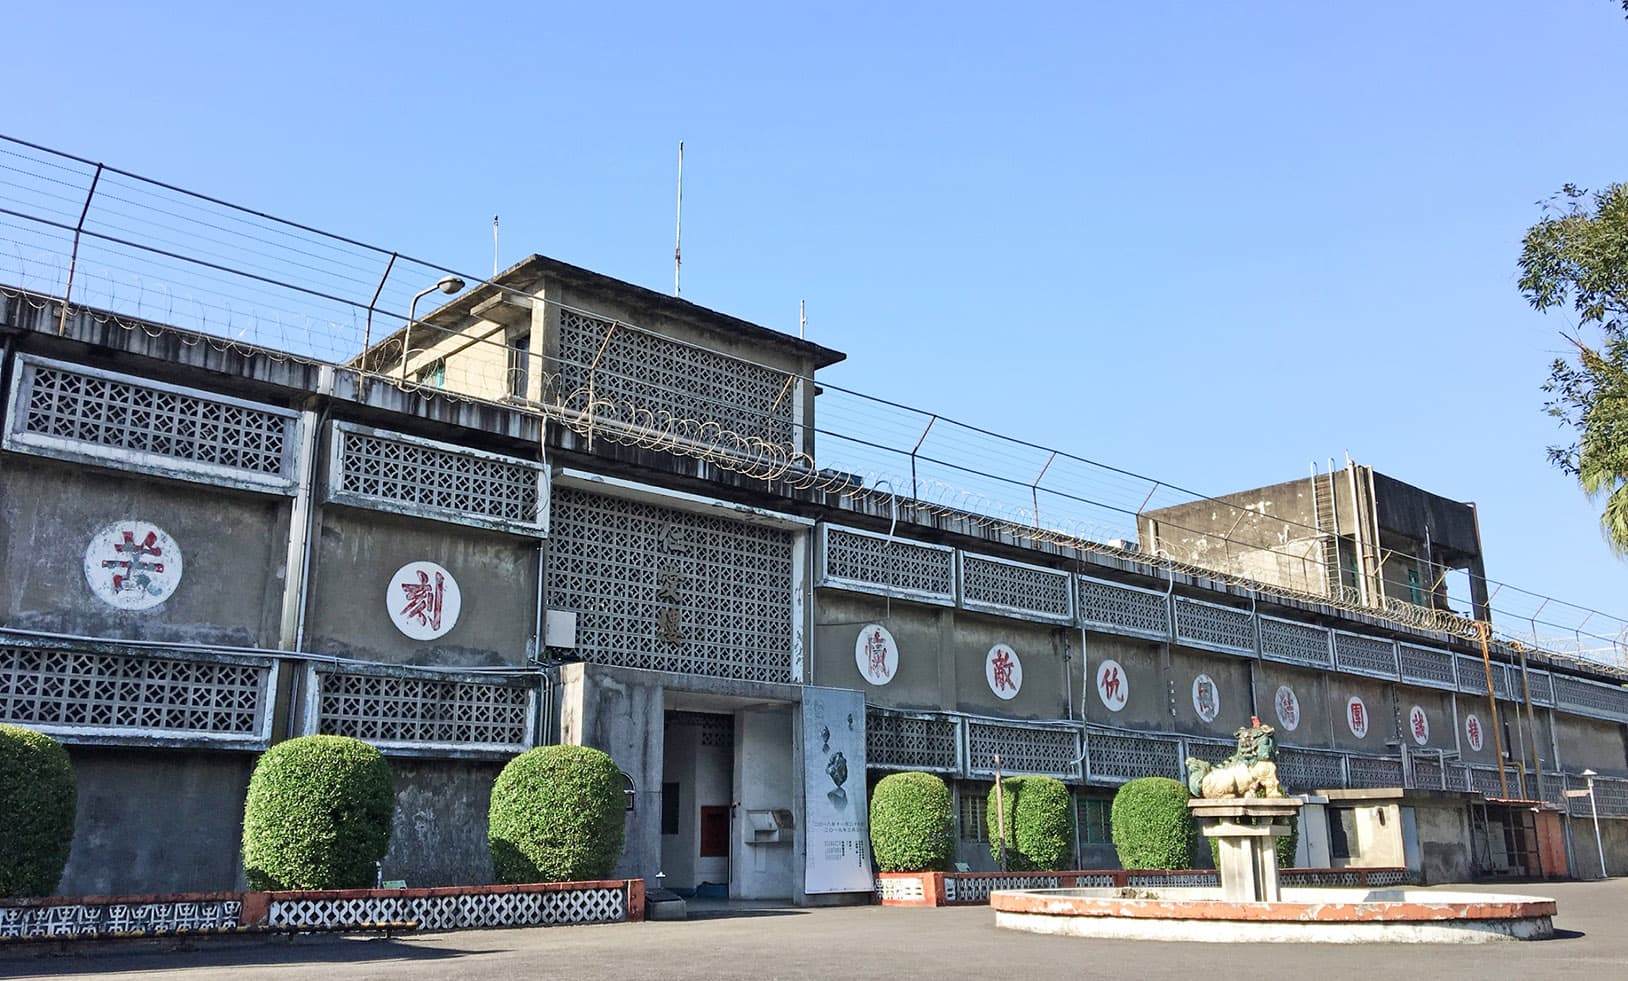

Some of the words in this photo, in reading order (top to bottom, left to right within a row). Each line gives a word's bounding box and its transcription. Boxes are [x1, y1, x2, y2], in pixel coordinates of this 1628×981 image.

[401, 569, 446, 631] 刻
[991, 649, 1017, 690] 敵
[1101, 667, 1125, 703] 仇
